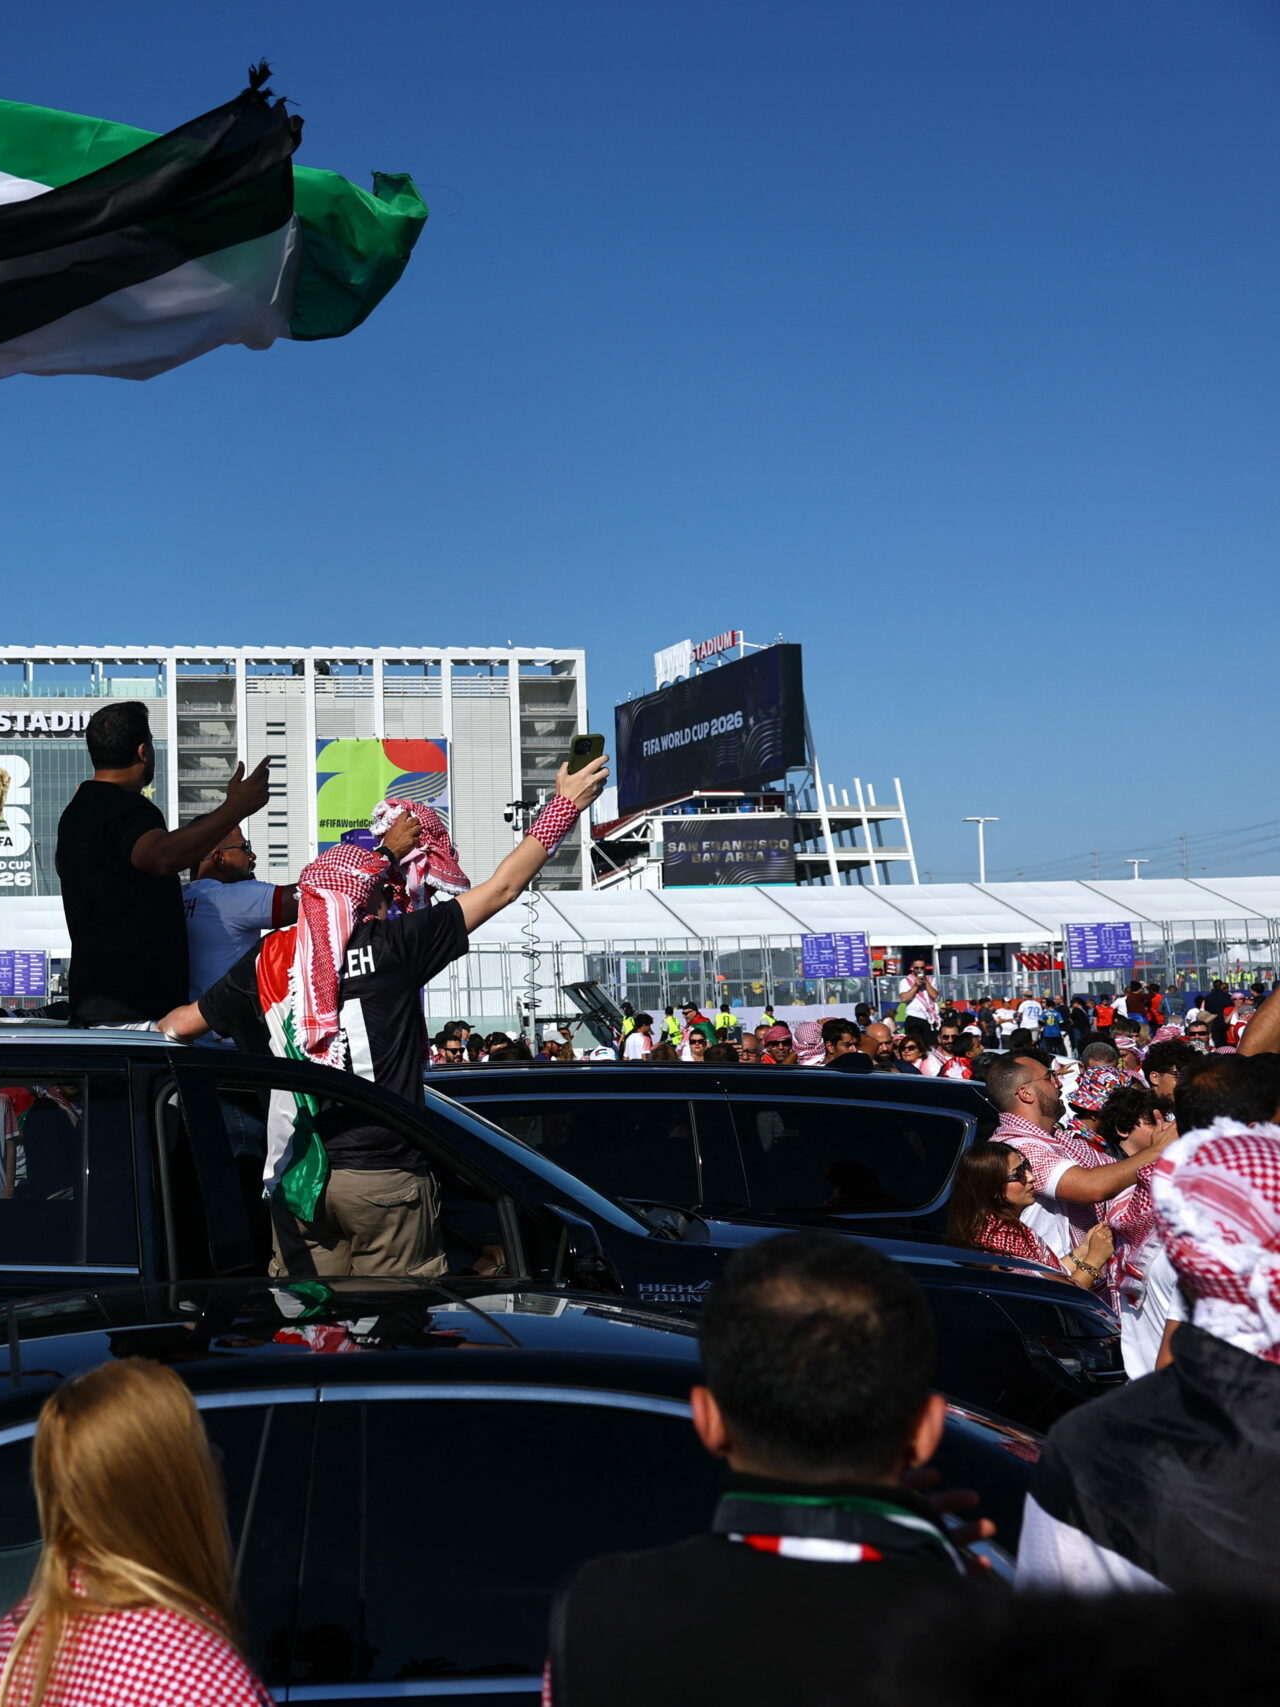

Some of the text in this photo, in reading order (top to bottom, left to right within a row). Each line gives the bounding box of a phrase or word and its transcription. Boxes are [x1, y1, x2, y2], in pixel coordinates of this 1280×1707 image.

[690, 630, 732, 661] STADIUM
[643, 710, 744, 757] FIFA WORLD CUP 2026
[668, 840, 789, 853] SAN FRANCISCO
[725, 851, 765, 862] AREA
[8, 861, 31, 870] CUP
[344, 945, 376, 979] EH
[639, 1283, 693, 1292] HIGH
[640, 1293, 703, 1303] COUN
